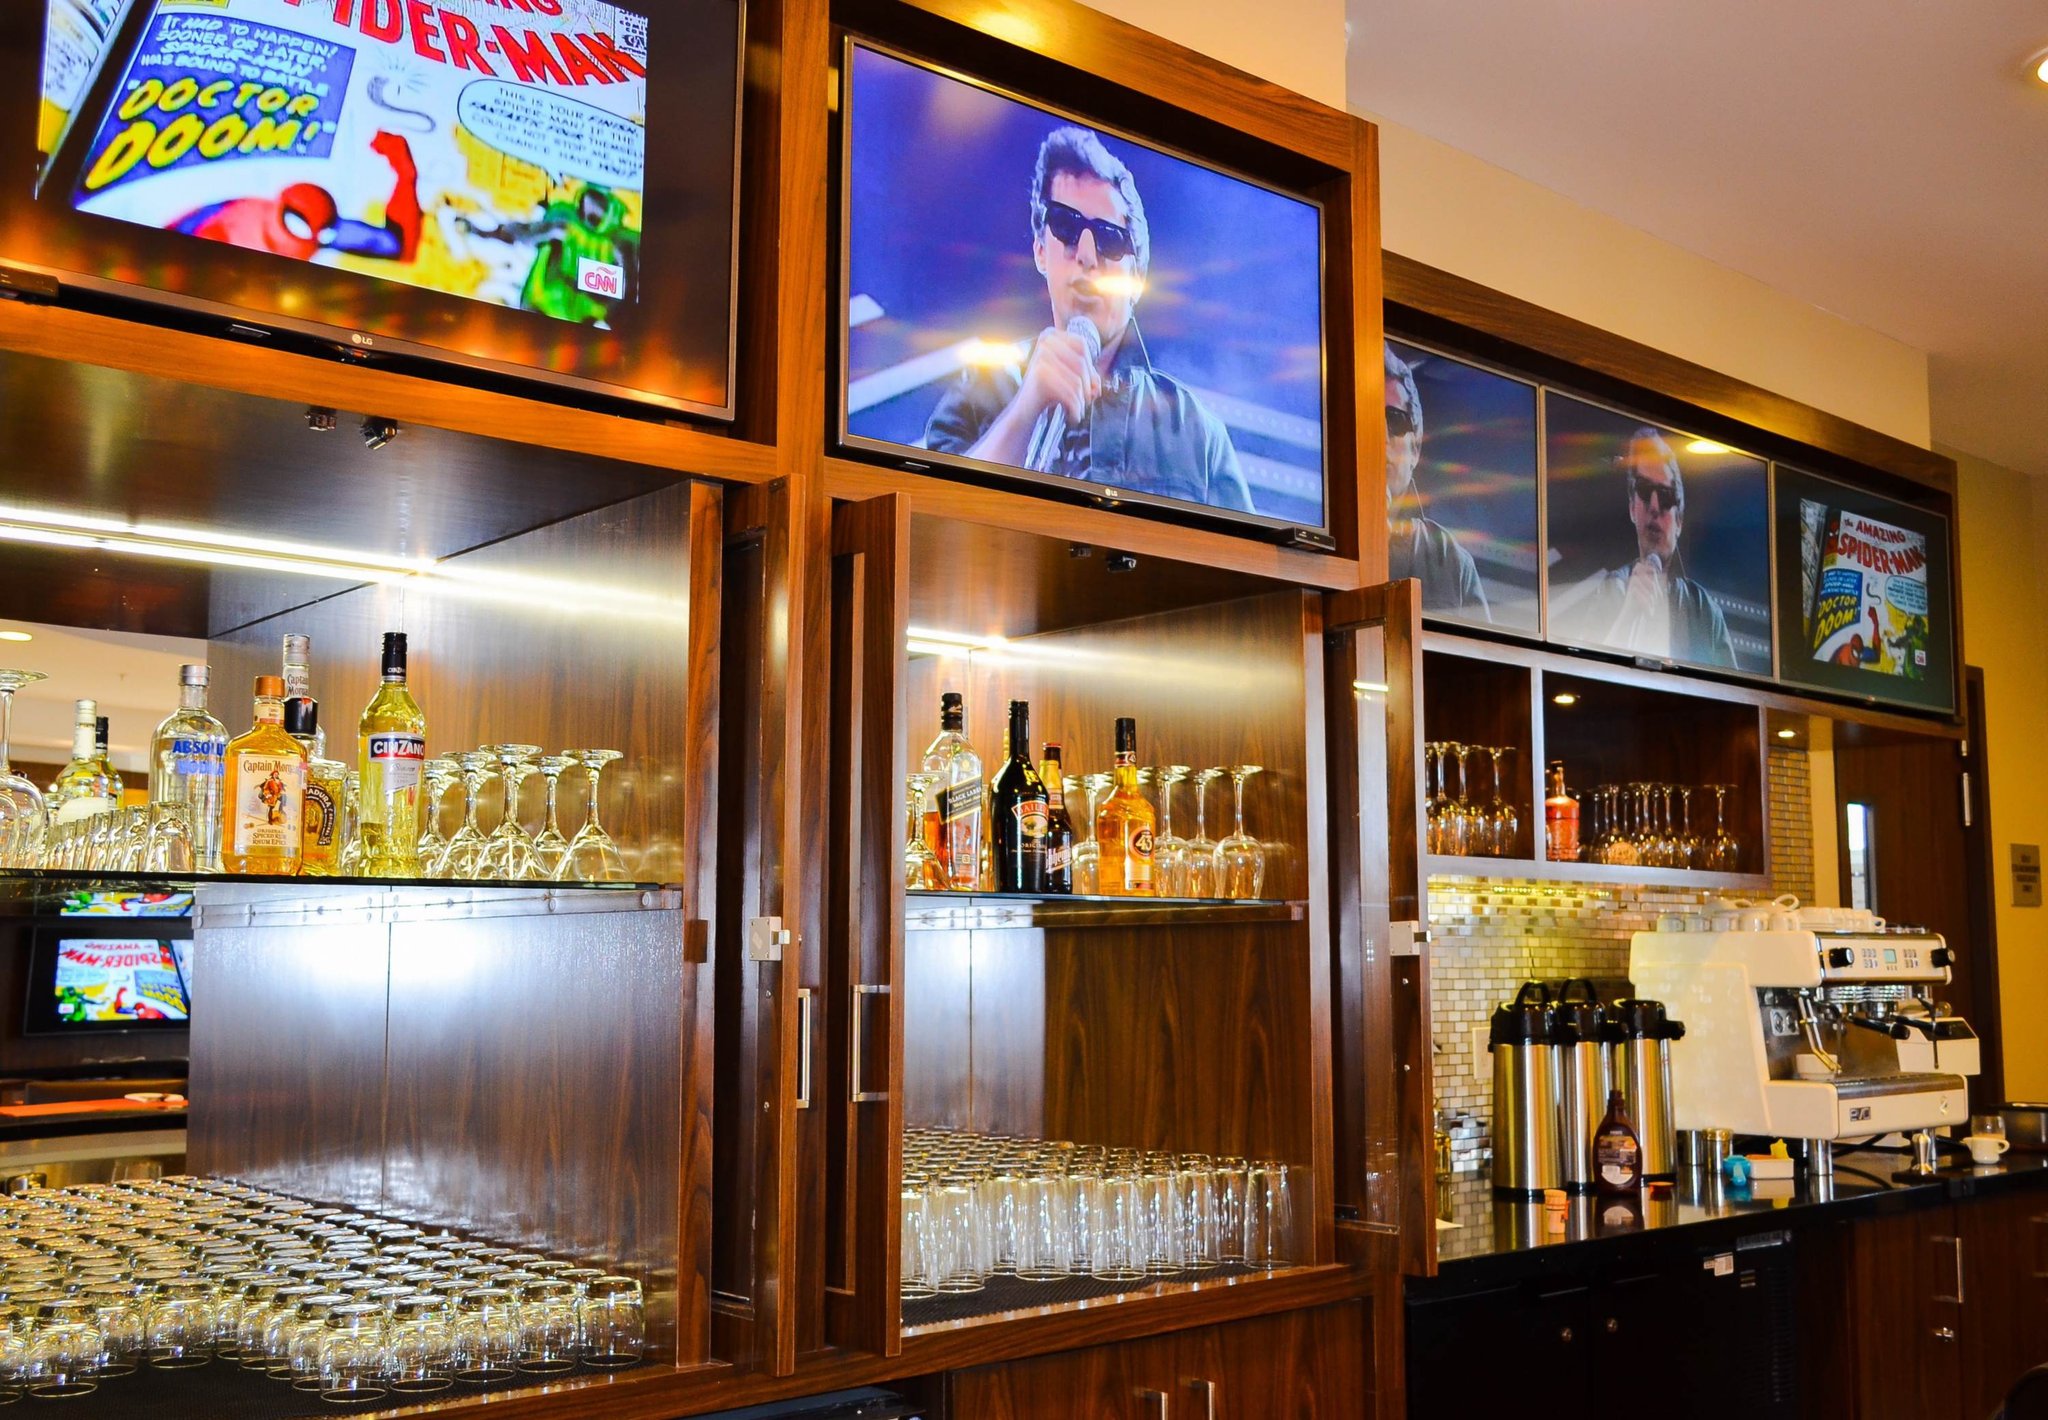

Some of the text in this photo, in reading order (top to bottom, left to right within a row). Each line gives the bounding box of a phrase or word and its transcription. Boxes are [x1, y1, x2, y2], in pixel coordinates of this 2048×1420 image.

[156, 29, 228, 48] SOONER
[232, 36, 259, 52] OR
[229, 21, 250, 36] TO
[253, 26, 338, 58] HAPPEN!
[175, 56, 236, 75] BOUND
[239, 62, 260, 79] TO
[499, 87, 526, 102] THIS
[531, 98, 543, 107] IS
[549, 102, 584, 121] YOUR
[1856, 520, 1906, 543] AMAZING
[1838, 533, 1926, 575] SPIDER-MAN
[173, 740, 226, 757] ABSOLU
[243, 760, 272, 774] Captain
[1135, 835, 1152, 851] 43
